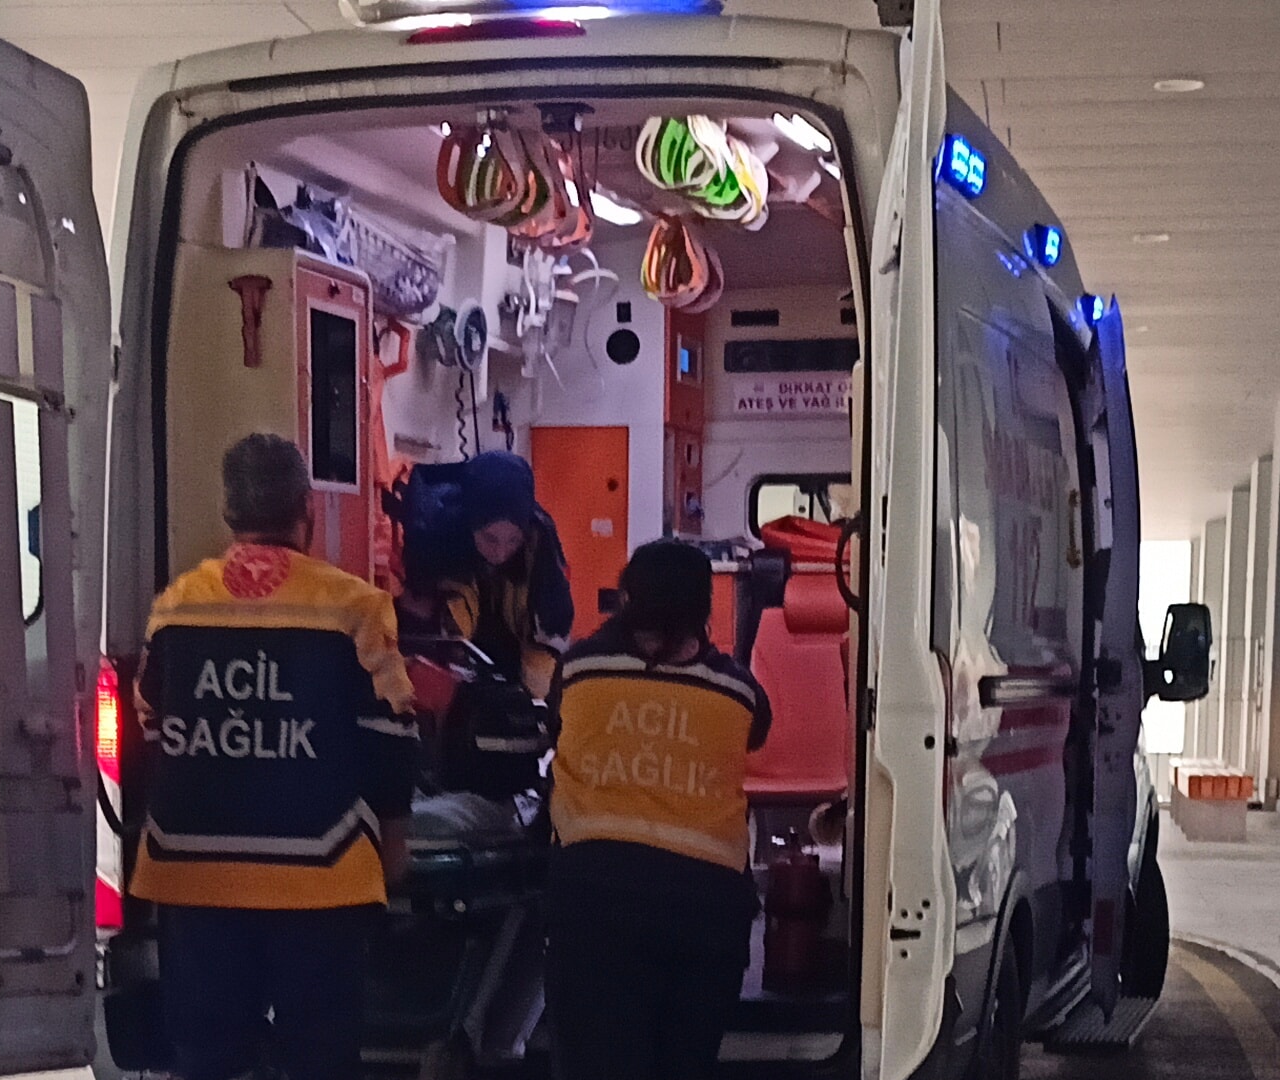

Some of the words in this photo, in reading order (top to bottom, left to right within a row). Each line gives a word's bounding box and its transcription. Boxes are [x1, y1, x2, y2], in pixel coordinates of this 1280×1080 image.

[778, 397, 797, 409] VE
[194, 650, 293, 701] ACİL
[160, 707, 318, 760] SAĞLIK
[606, 699, 700, 747] ACİL
